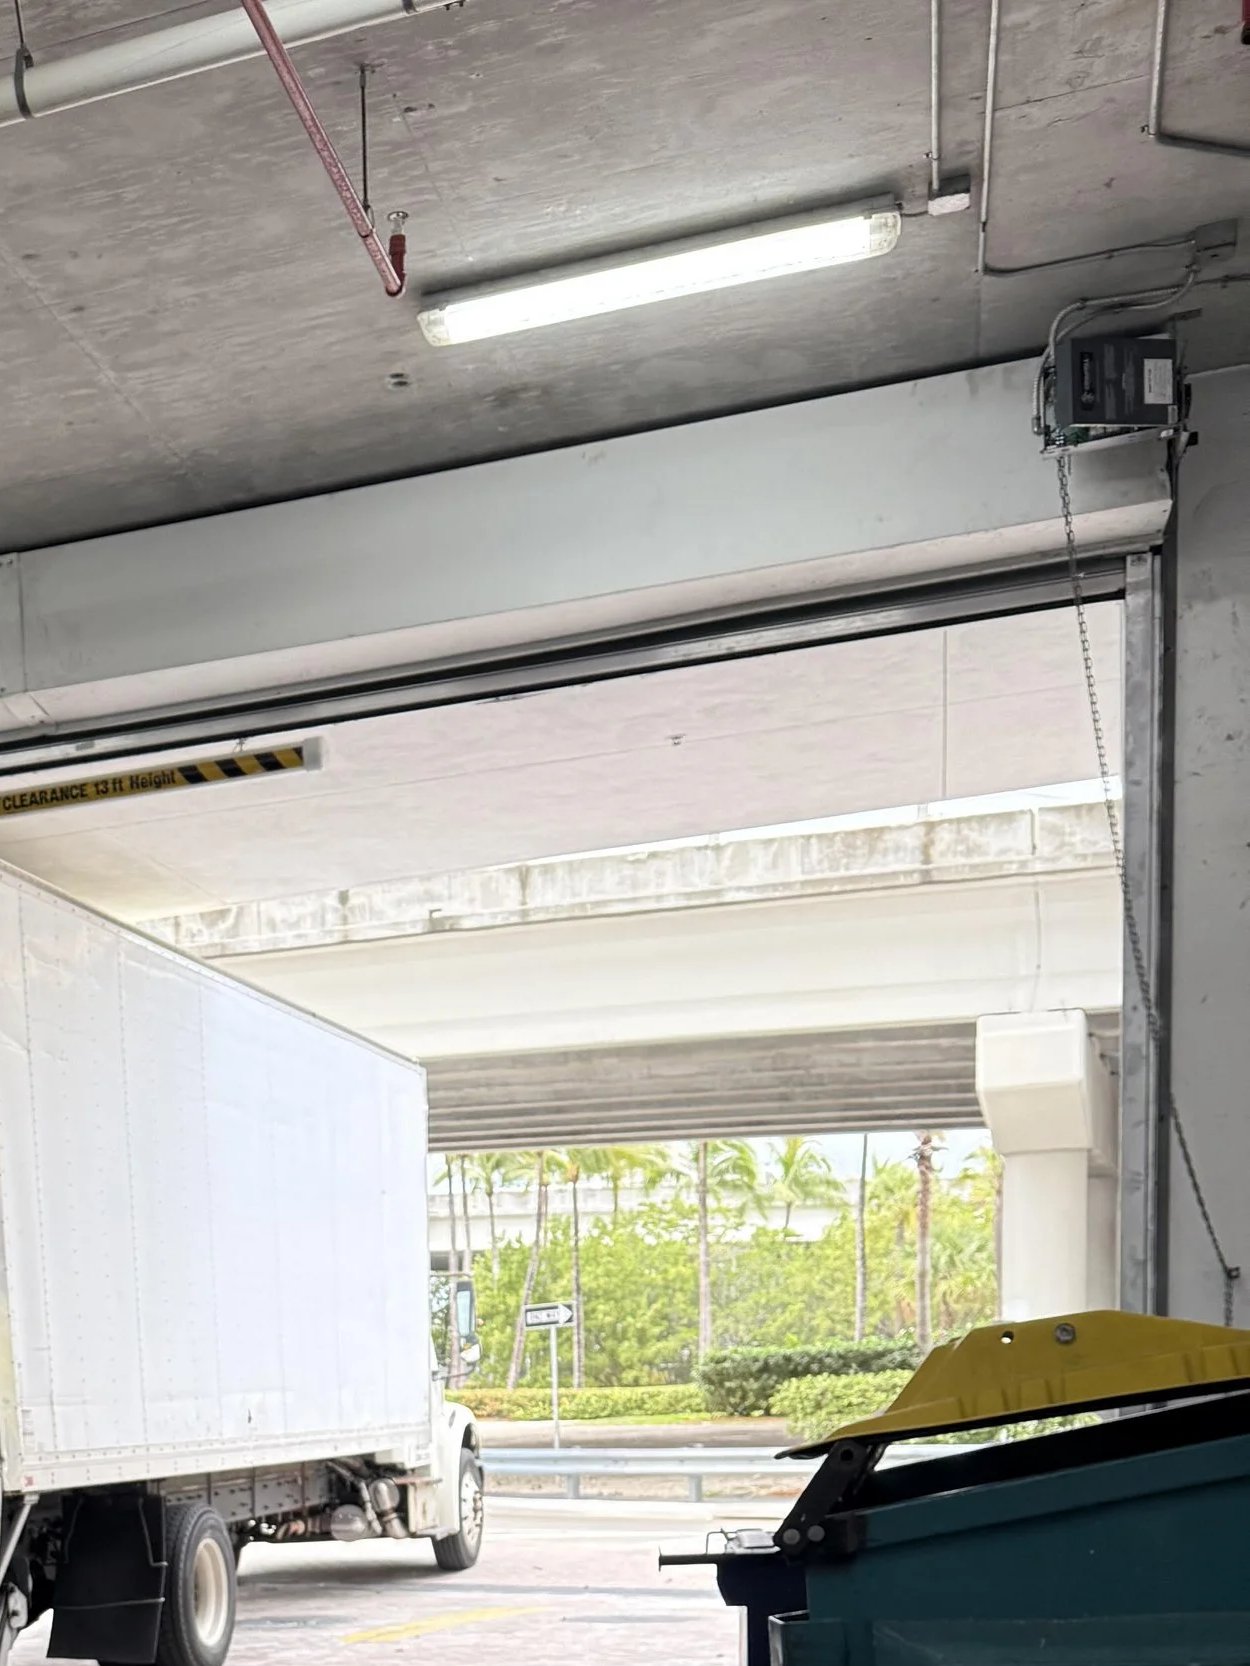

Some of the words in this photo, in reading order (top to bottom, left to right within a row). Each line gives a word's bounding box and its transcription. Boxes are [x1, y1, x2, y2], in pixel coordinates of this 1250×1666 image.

[2, 783, 88, 811] CLEARANCE
[94, 782, 109, 796] 13
[129, 770, 177, 791] Height
